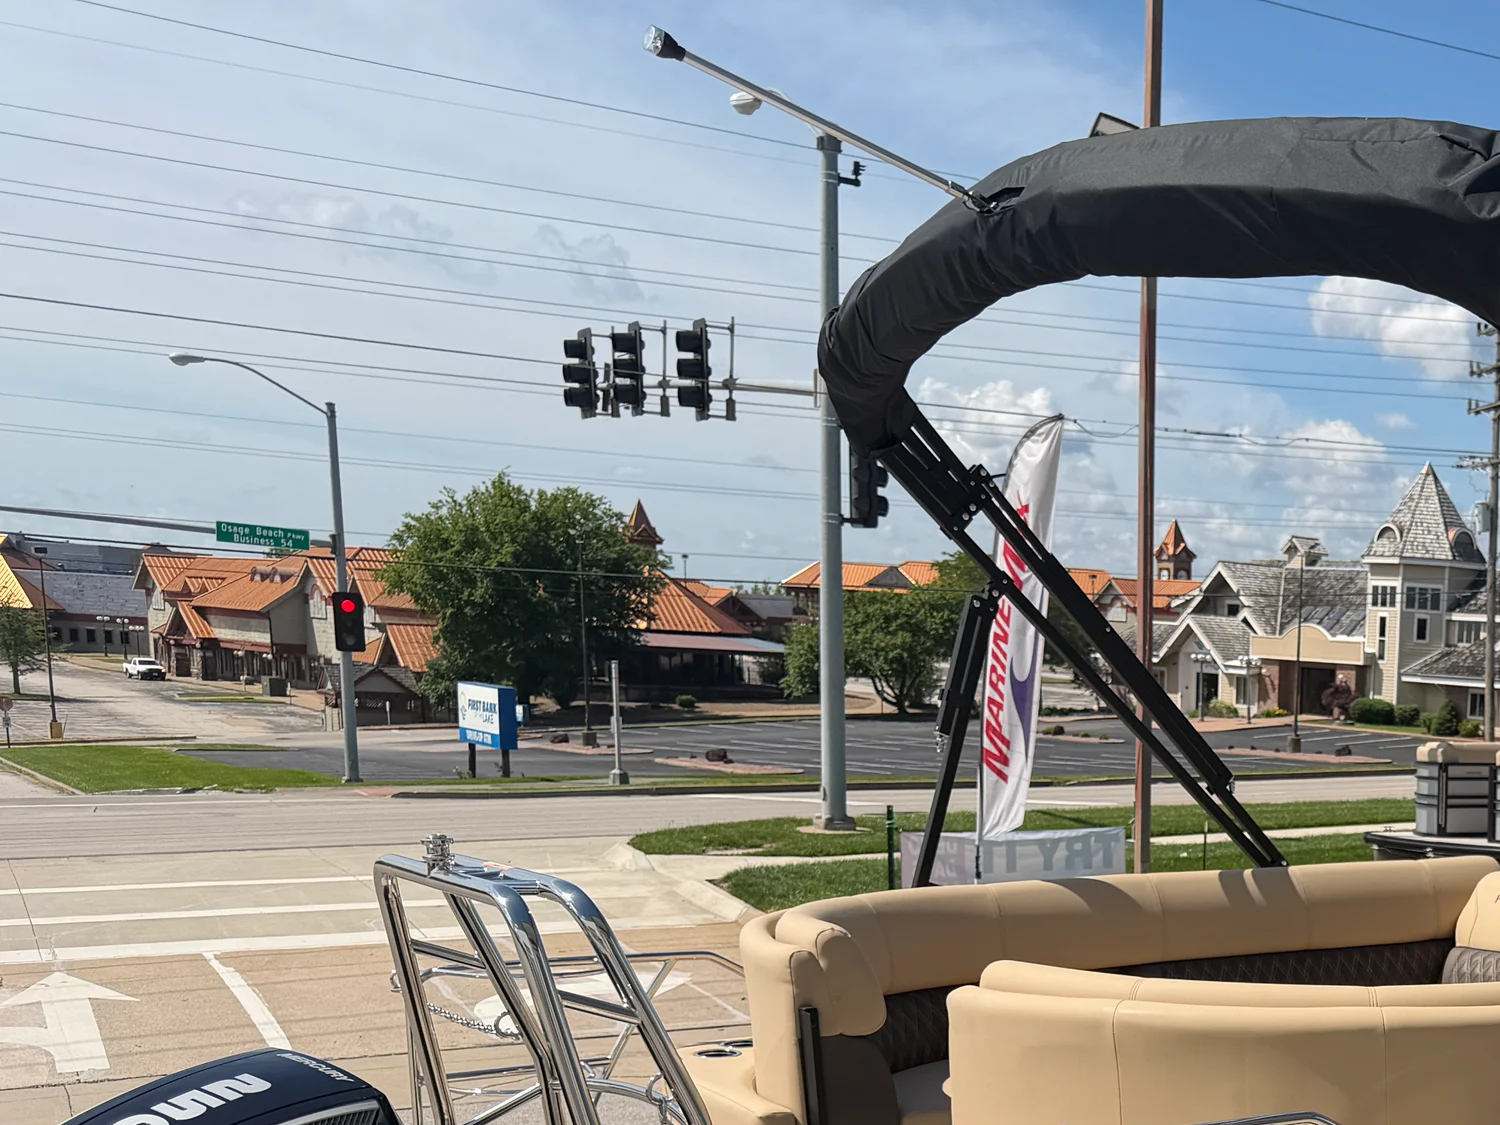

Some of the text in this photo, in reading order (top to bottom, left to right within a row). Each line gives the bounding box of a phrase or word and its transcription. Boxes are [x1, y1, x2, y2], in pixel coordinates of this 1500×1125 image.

[221, 523, 305, 541] Osage Beach Pkwy
[233, 533, 294, 547] Business 54
[468, 698, 498, 714] FIRST BANK
[277, 1053, 355, 1083] MERCURY
